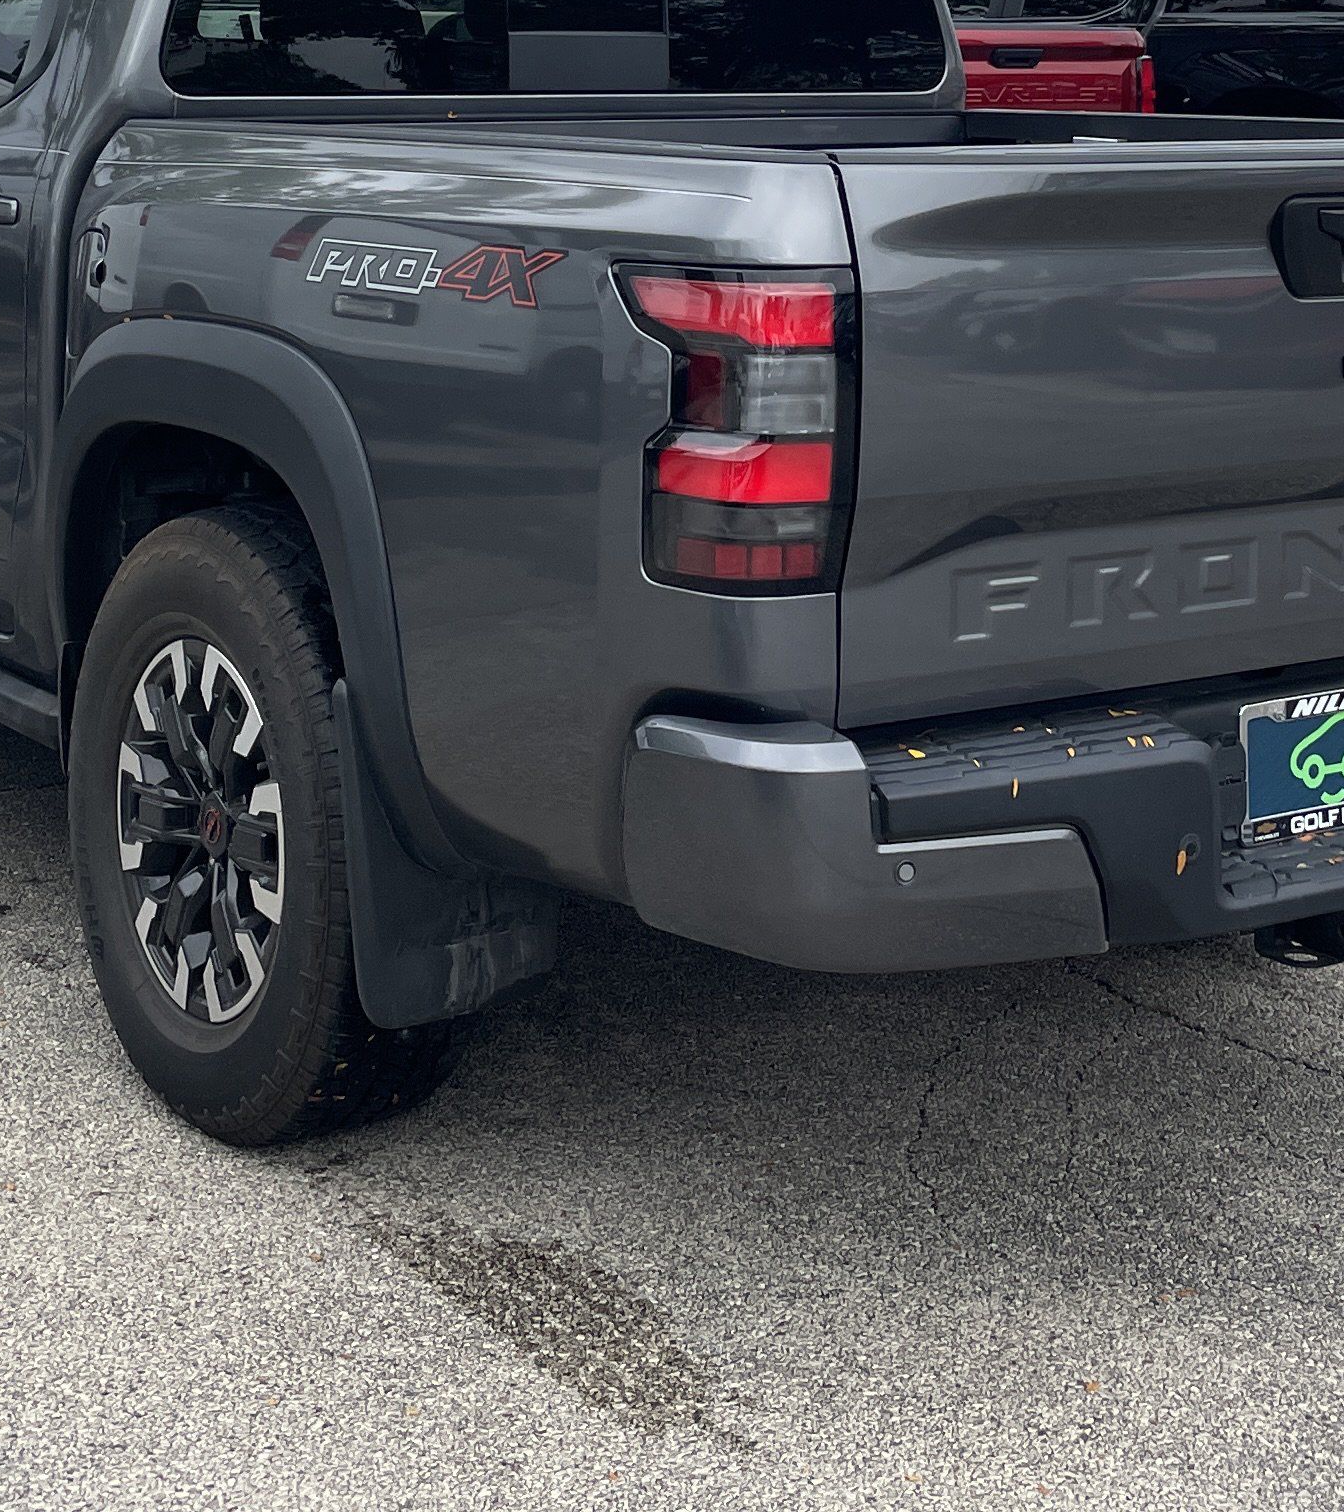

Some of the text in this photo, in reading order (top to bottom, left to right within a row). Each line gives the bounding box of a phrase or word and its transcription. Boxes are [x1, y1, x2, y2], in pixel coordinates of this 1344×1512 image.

[965, 82, 1118, 103] EVROLET
[305, 237, 570, 310] PRO-4X
[1290, 808, 1340, 835] GOLF
